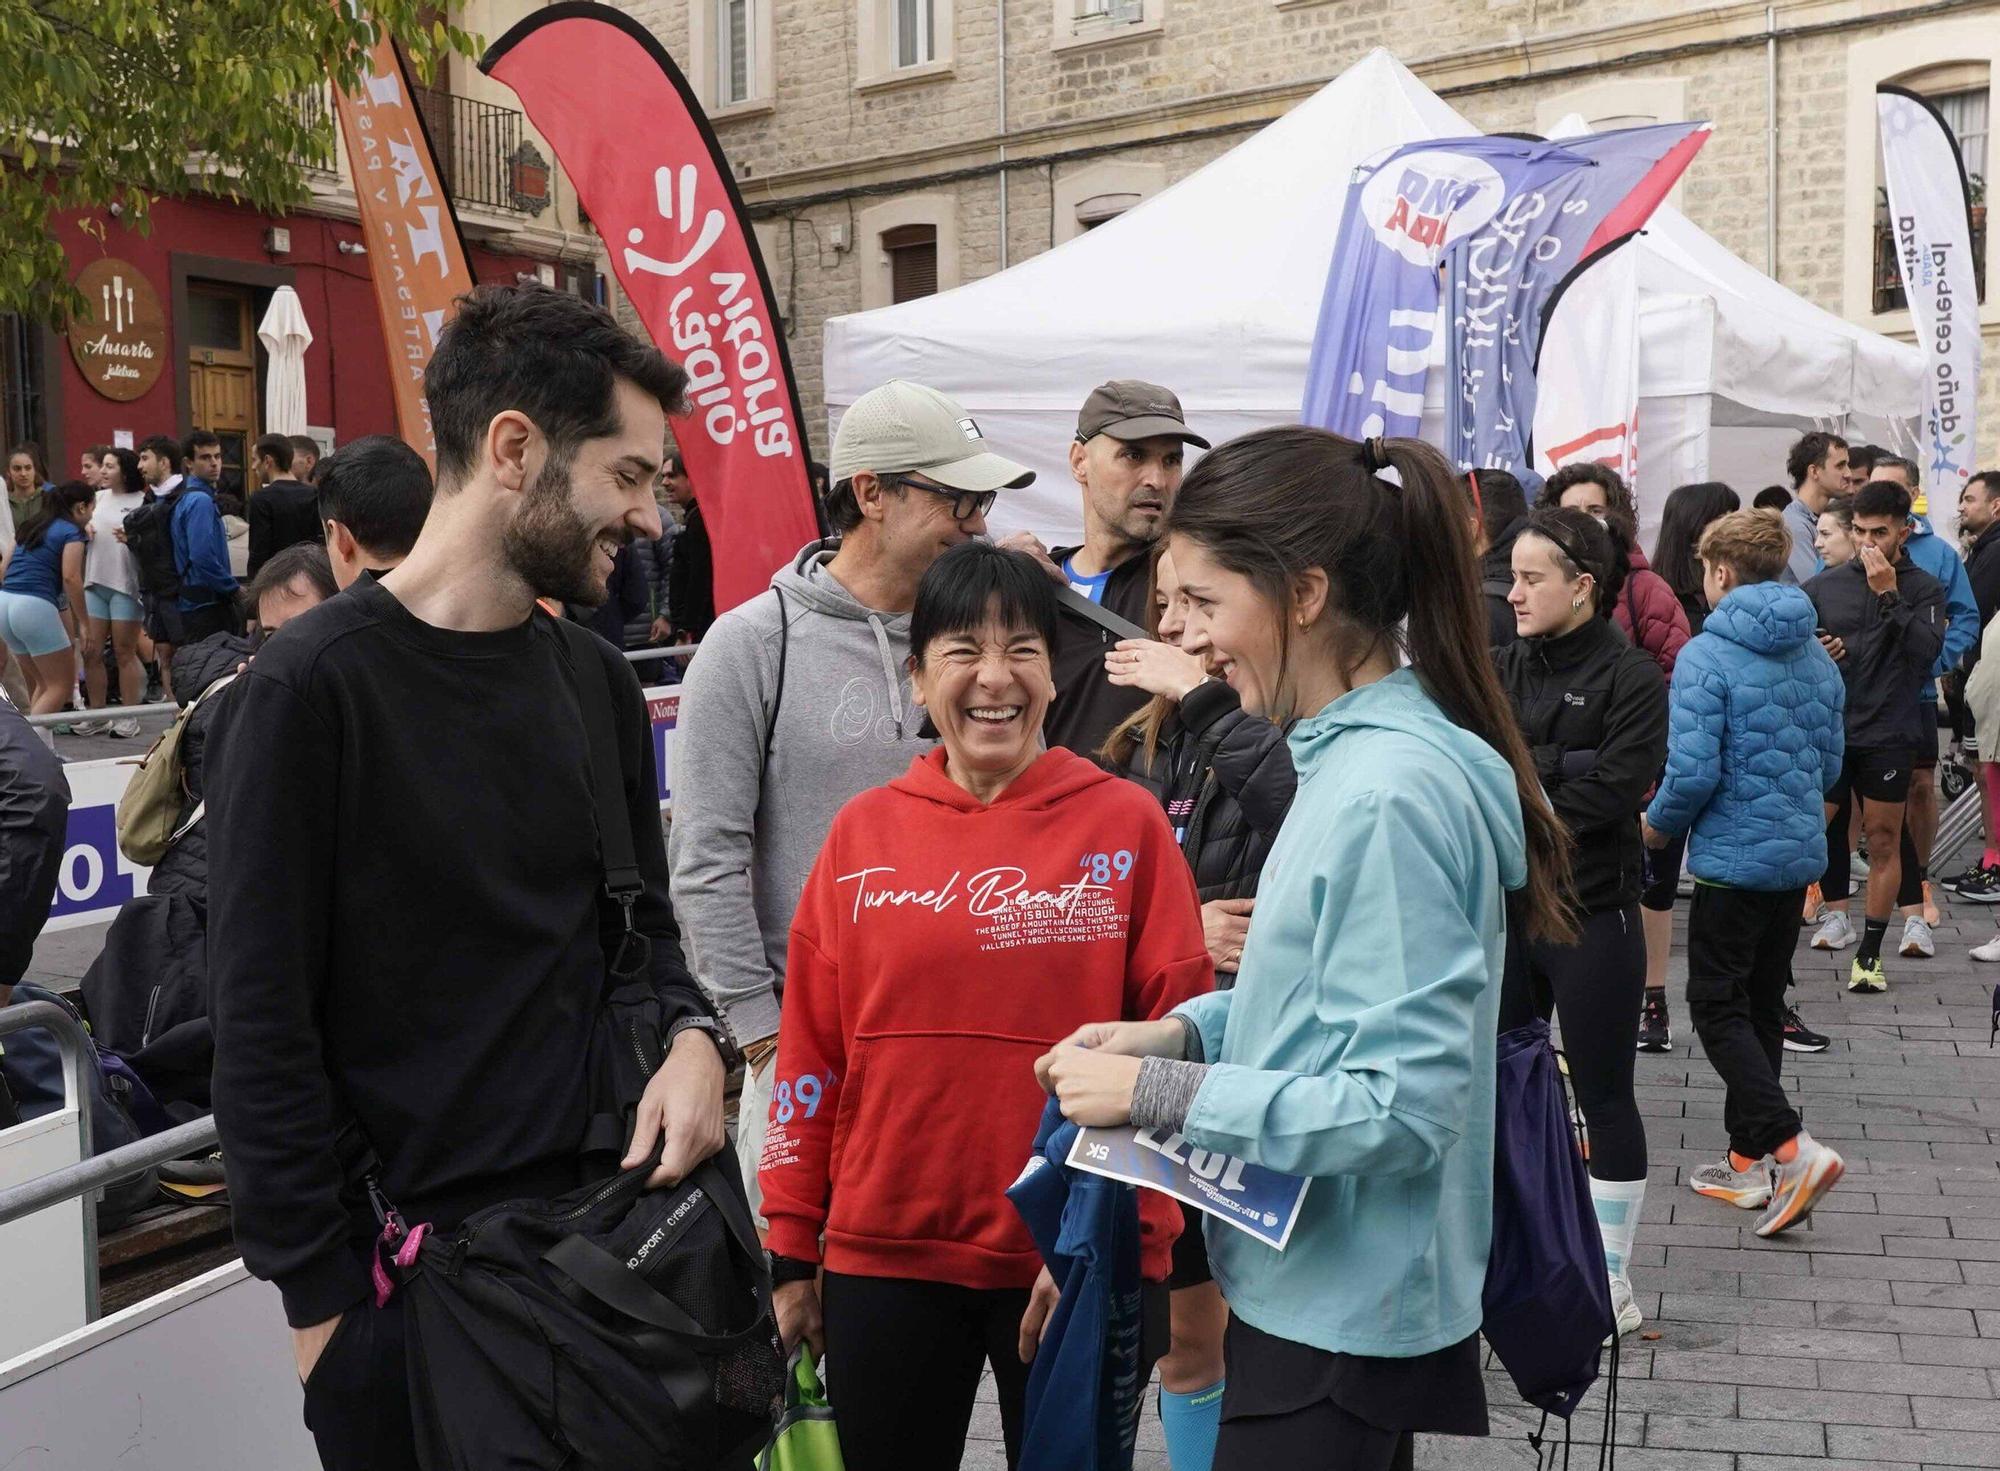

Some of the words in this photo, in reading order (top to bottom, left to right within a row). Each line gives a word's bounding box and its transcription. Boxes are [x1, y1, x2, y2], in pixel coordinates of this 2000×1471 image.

[84, 334, 154, 358] Ausarta
[836, 866, 961, 923] Tunnel
[967, 866, 1113, 925] Beast
[975, 927, 991, 936] THE
[991, 924, 1011, 934] BASE
[1011, 923, 1020, 931] OF
[1027, 919, 1065, 929] MOUNTAIN
[1087, 916, 1105, 925] THIS
[1105, 914, 1123, 924] TYPE
[992, 912, 1021, 925] THAT
[1023, 911, 1034, 921] IS
[992, 931, 1022, 941] TUNNEL
[1023, 927, 1064, 937] TYPICALLY
[1064, 925, 1102, 935] CONNECTS
[1102, 923, 1118, 932] TWO
[980, 939, 1015, 951] VALLEYS
[1015, 938, 1026, 946] AT
[1027, 936, 1052, 944] ABOUT
[1052, 934, 1067, 942] THE
[1067, 933, 1087, 942] SAME
[1086, 1142, 1110, 1161] 5K
